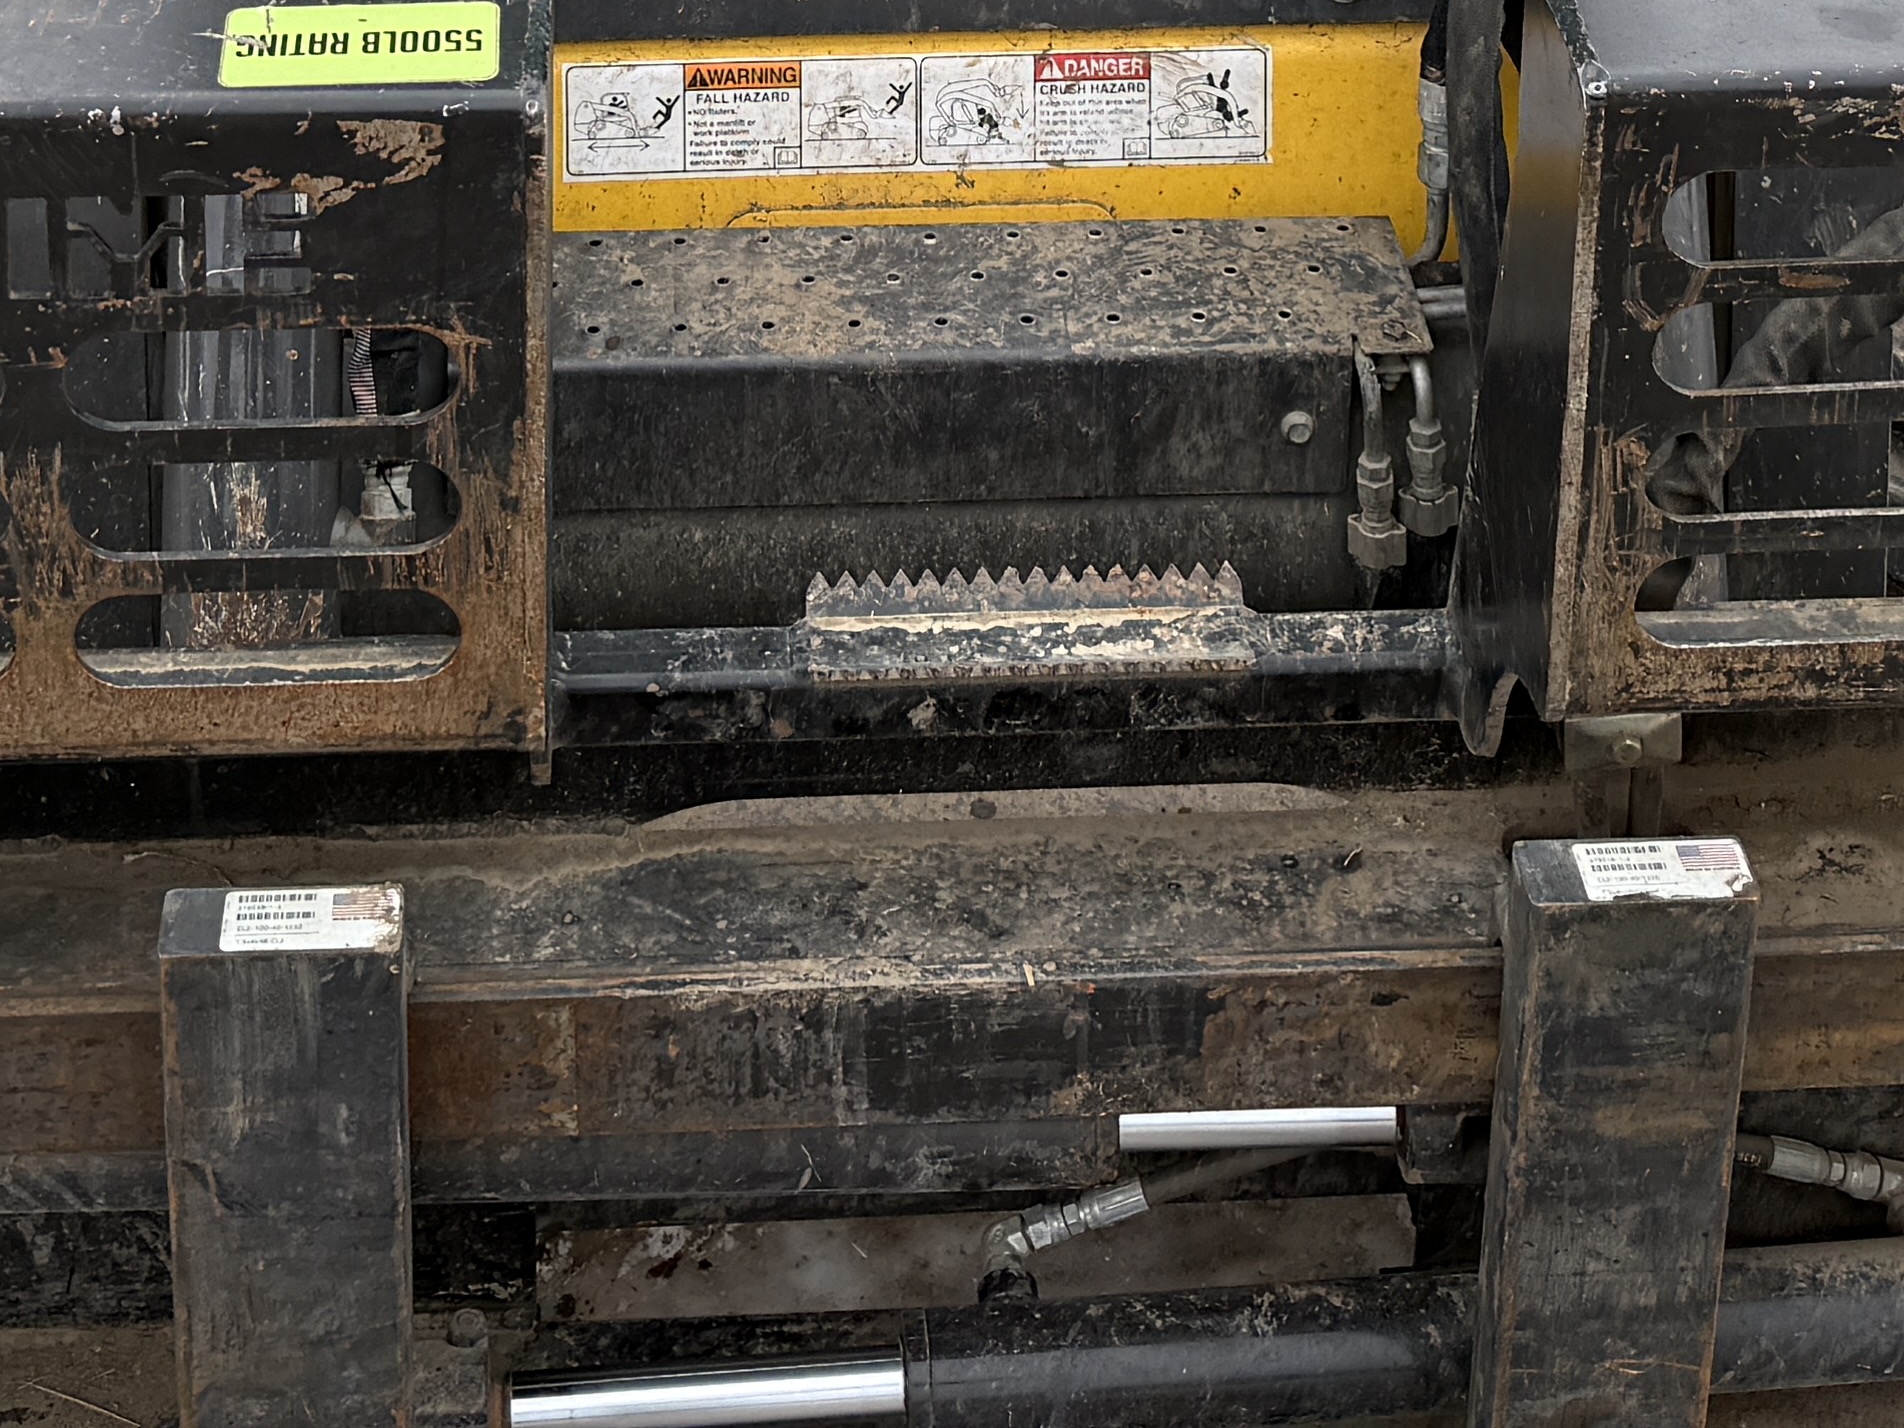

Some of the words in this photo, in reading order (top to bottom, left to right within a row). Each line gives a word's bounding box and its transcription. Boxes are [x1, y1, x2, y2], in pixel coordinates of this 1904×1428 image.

[235, 32, 349, 58] RATING
[362, 29, 483, 54] 5500LB
[707, 66, 797, 86] WARNING
[1064, 57, 1144, 77] DANGER
[697, 93, 729, 104] FALL
[733, 92, 790, 103] HAZARD
[1040, 84, 1086, 95] CRUSH
[1090, 82, 1146, 94] HAZARD
